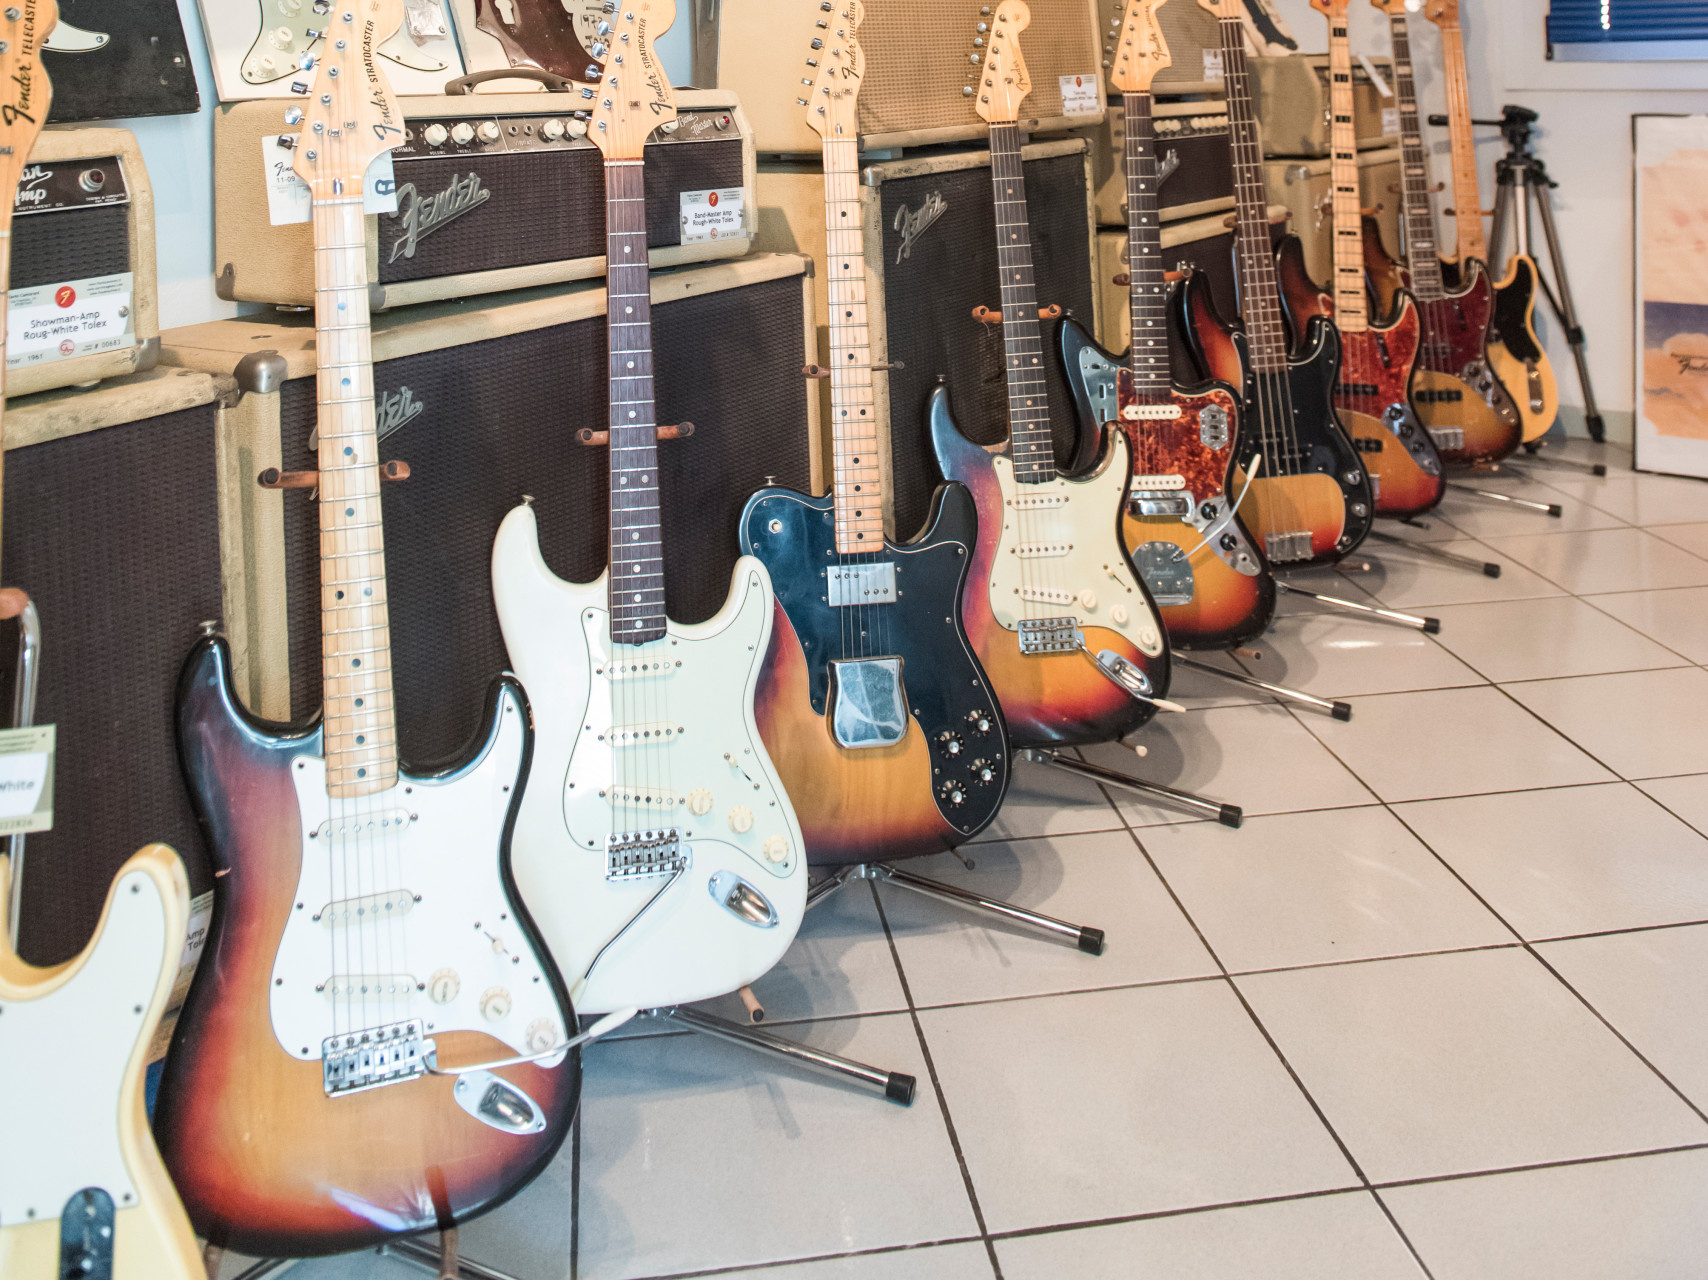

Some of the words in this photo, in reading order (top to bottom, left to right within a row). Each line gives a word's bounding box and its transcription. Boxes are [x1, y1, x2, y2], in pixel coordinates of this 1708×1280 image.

[849, 1, 857, 40] TELECASTER
[362, 19, 379, 83] STRATOCASTER
[638, 18, 653, 70] STRATOCASTER
[841, 42, 860, 80] Fender
[1, 60, 36, 127] Fender
[646, 72, 673, 116] Fender
[1010, 59, 1029, 92] Fender
[371, 86, 402, 141] Fender
[276, 175, 296, 183] 11-09
[388, 171, 491, 265] Fender
[692, 218, 721, 226] Rough-White
[694, 211, 722, 219] Band-Master
[893, 190, 949, 265] Fender
[23, 325, 79, 340] Roug-White
[82, 319, 107, 333] Tolex
[30, 311, 100, 329] Showman-Amp
[28, 353, 43, 361] 1961
[188, 938, 206, 952] Tol
